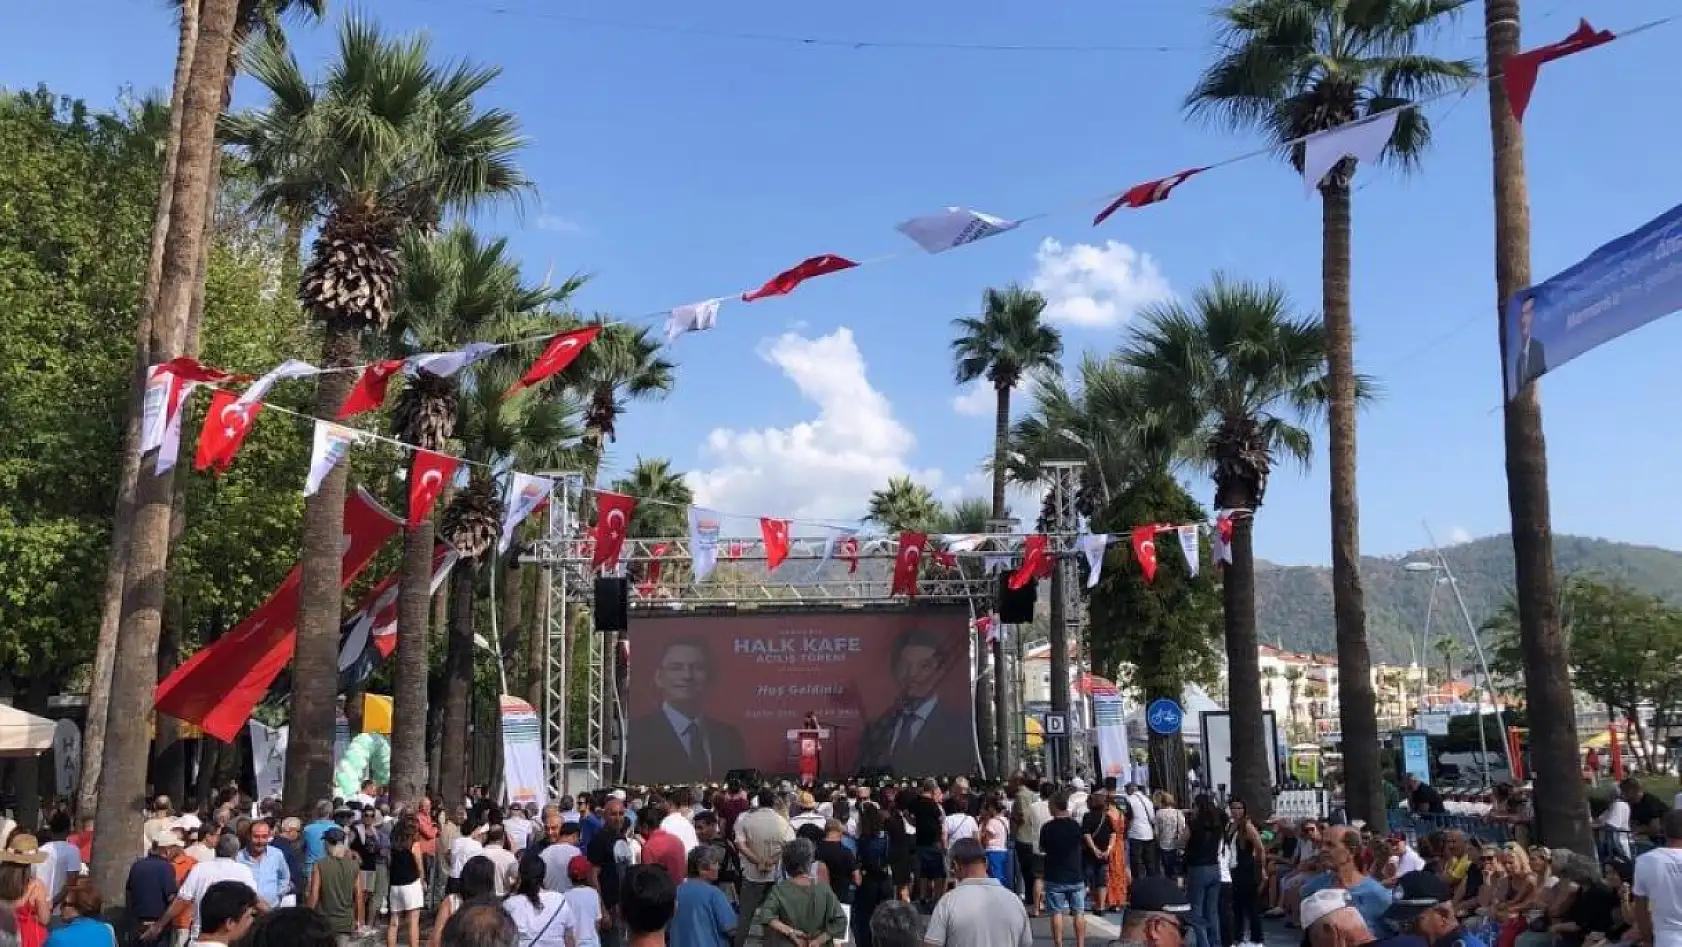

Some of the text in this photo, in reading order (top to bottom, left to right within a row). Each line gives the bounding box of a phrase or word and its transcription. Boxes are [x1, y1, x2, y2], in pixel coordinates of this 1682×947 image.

[734, 637, 862, 653] HALK KAFE
[1052, 718, 1061, 730] D
